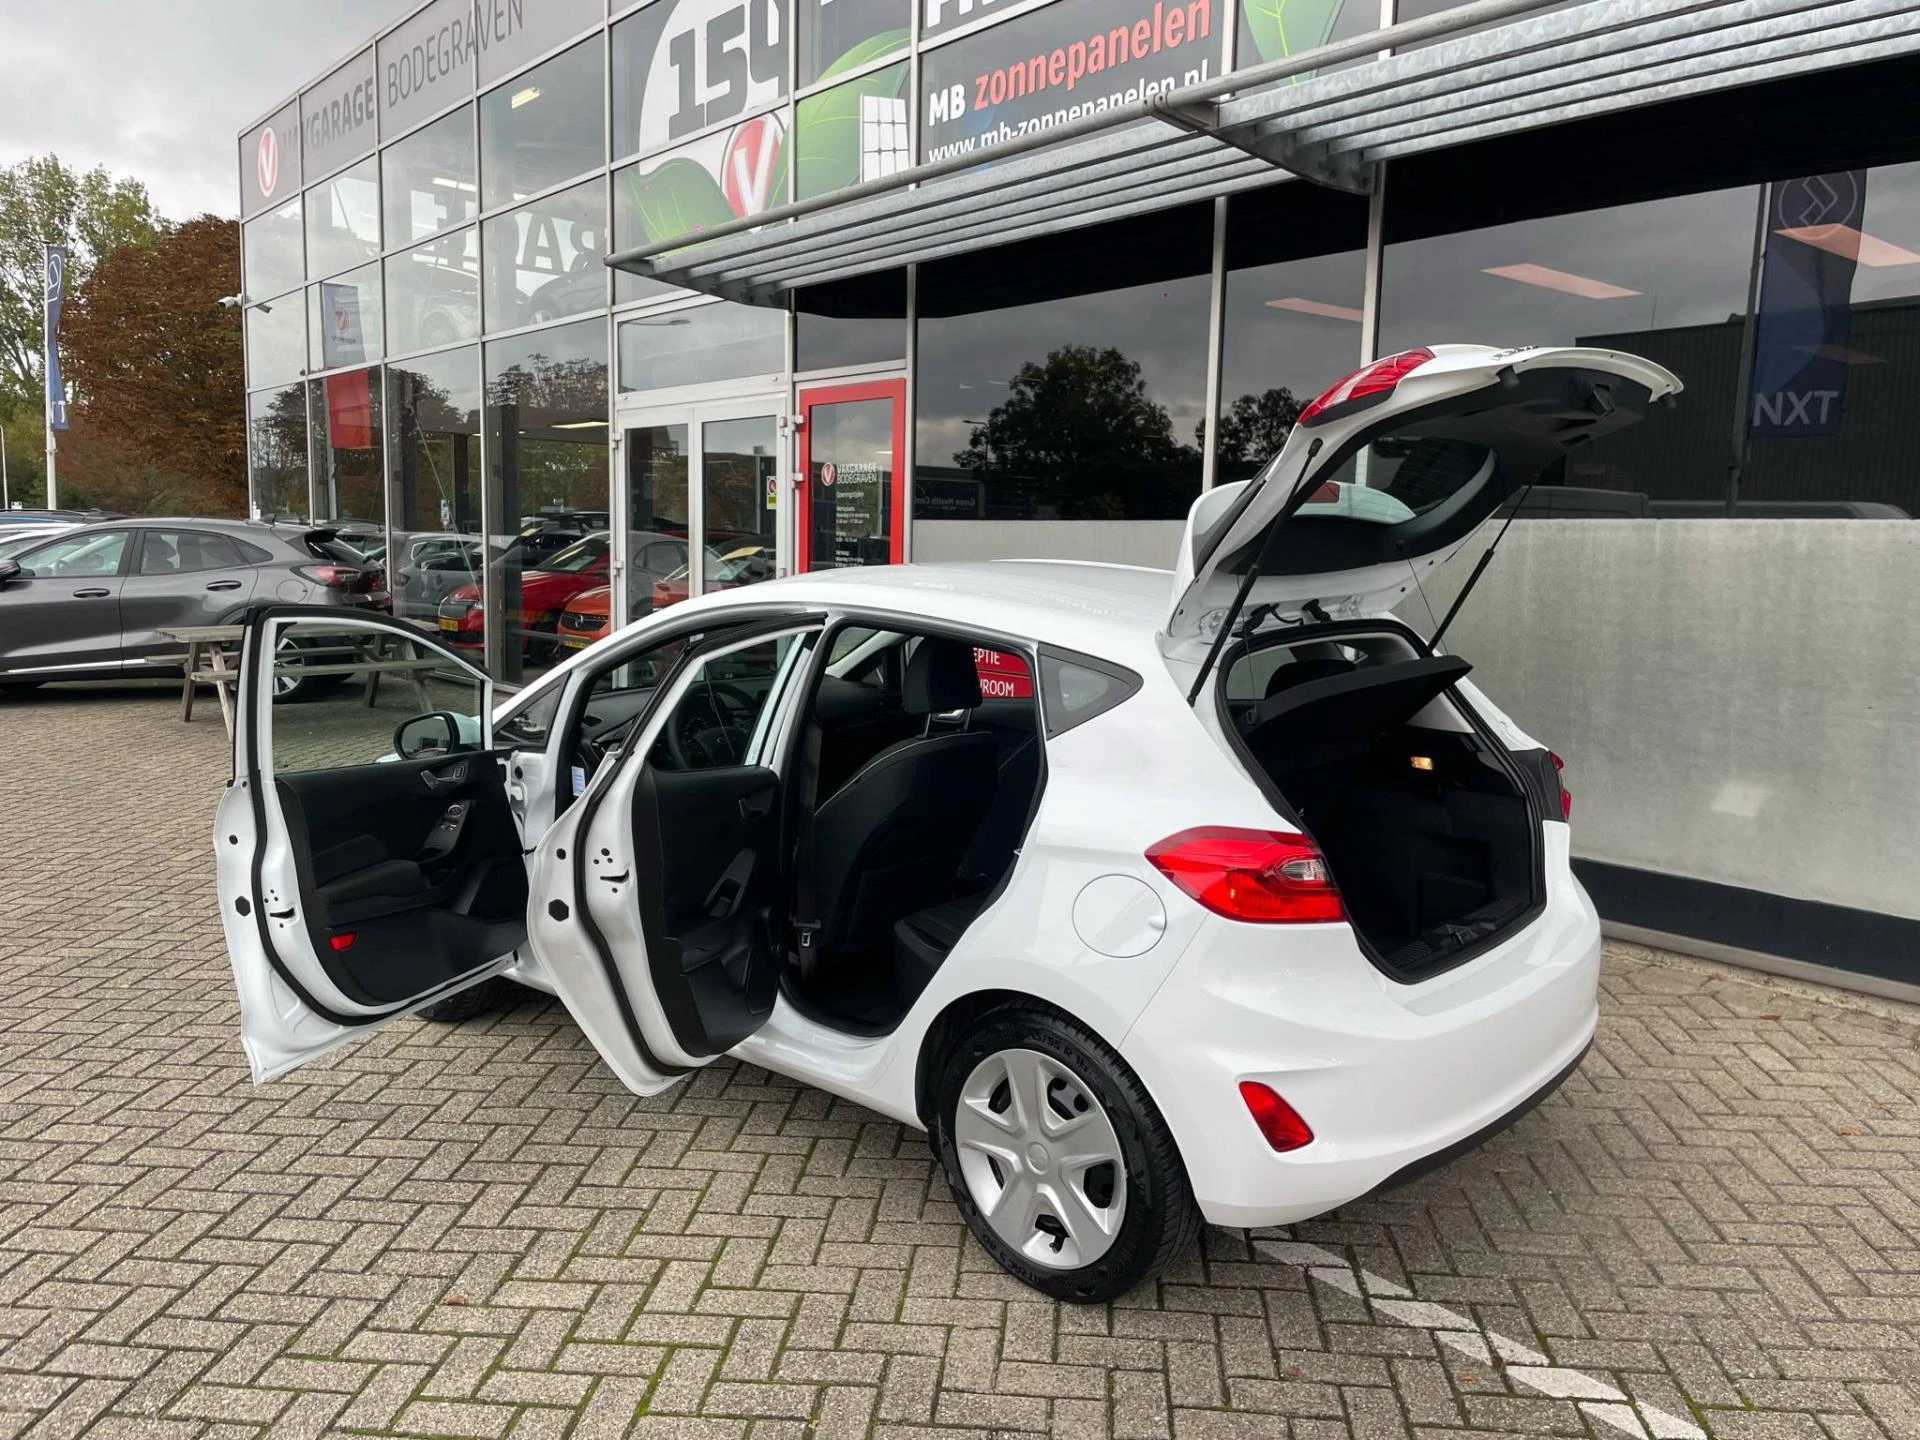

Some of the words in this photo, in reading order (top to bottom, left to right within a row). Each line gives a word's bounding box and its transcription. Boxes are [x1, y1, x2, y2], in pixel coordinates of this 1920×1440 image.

[928, 83, 966, 127] MB
[974, 0, 1211, 112] zonnepanelen
[1752, 390, 1839, 427] NXT
[836, 472, 877, 485] BODEGRAVEN
